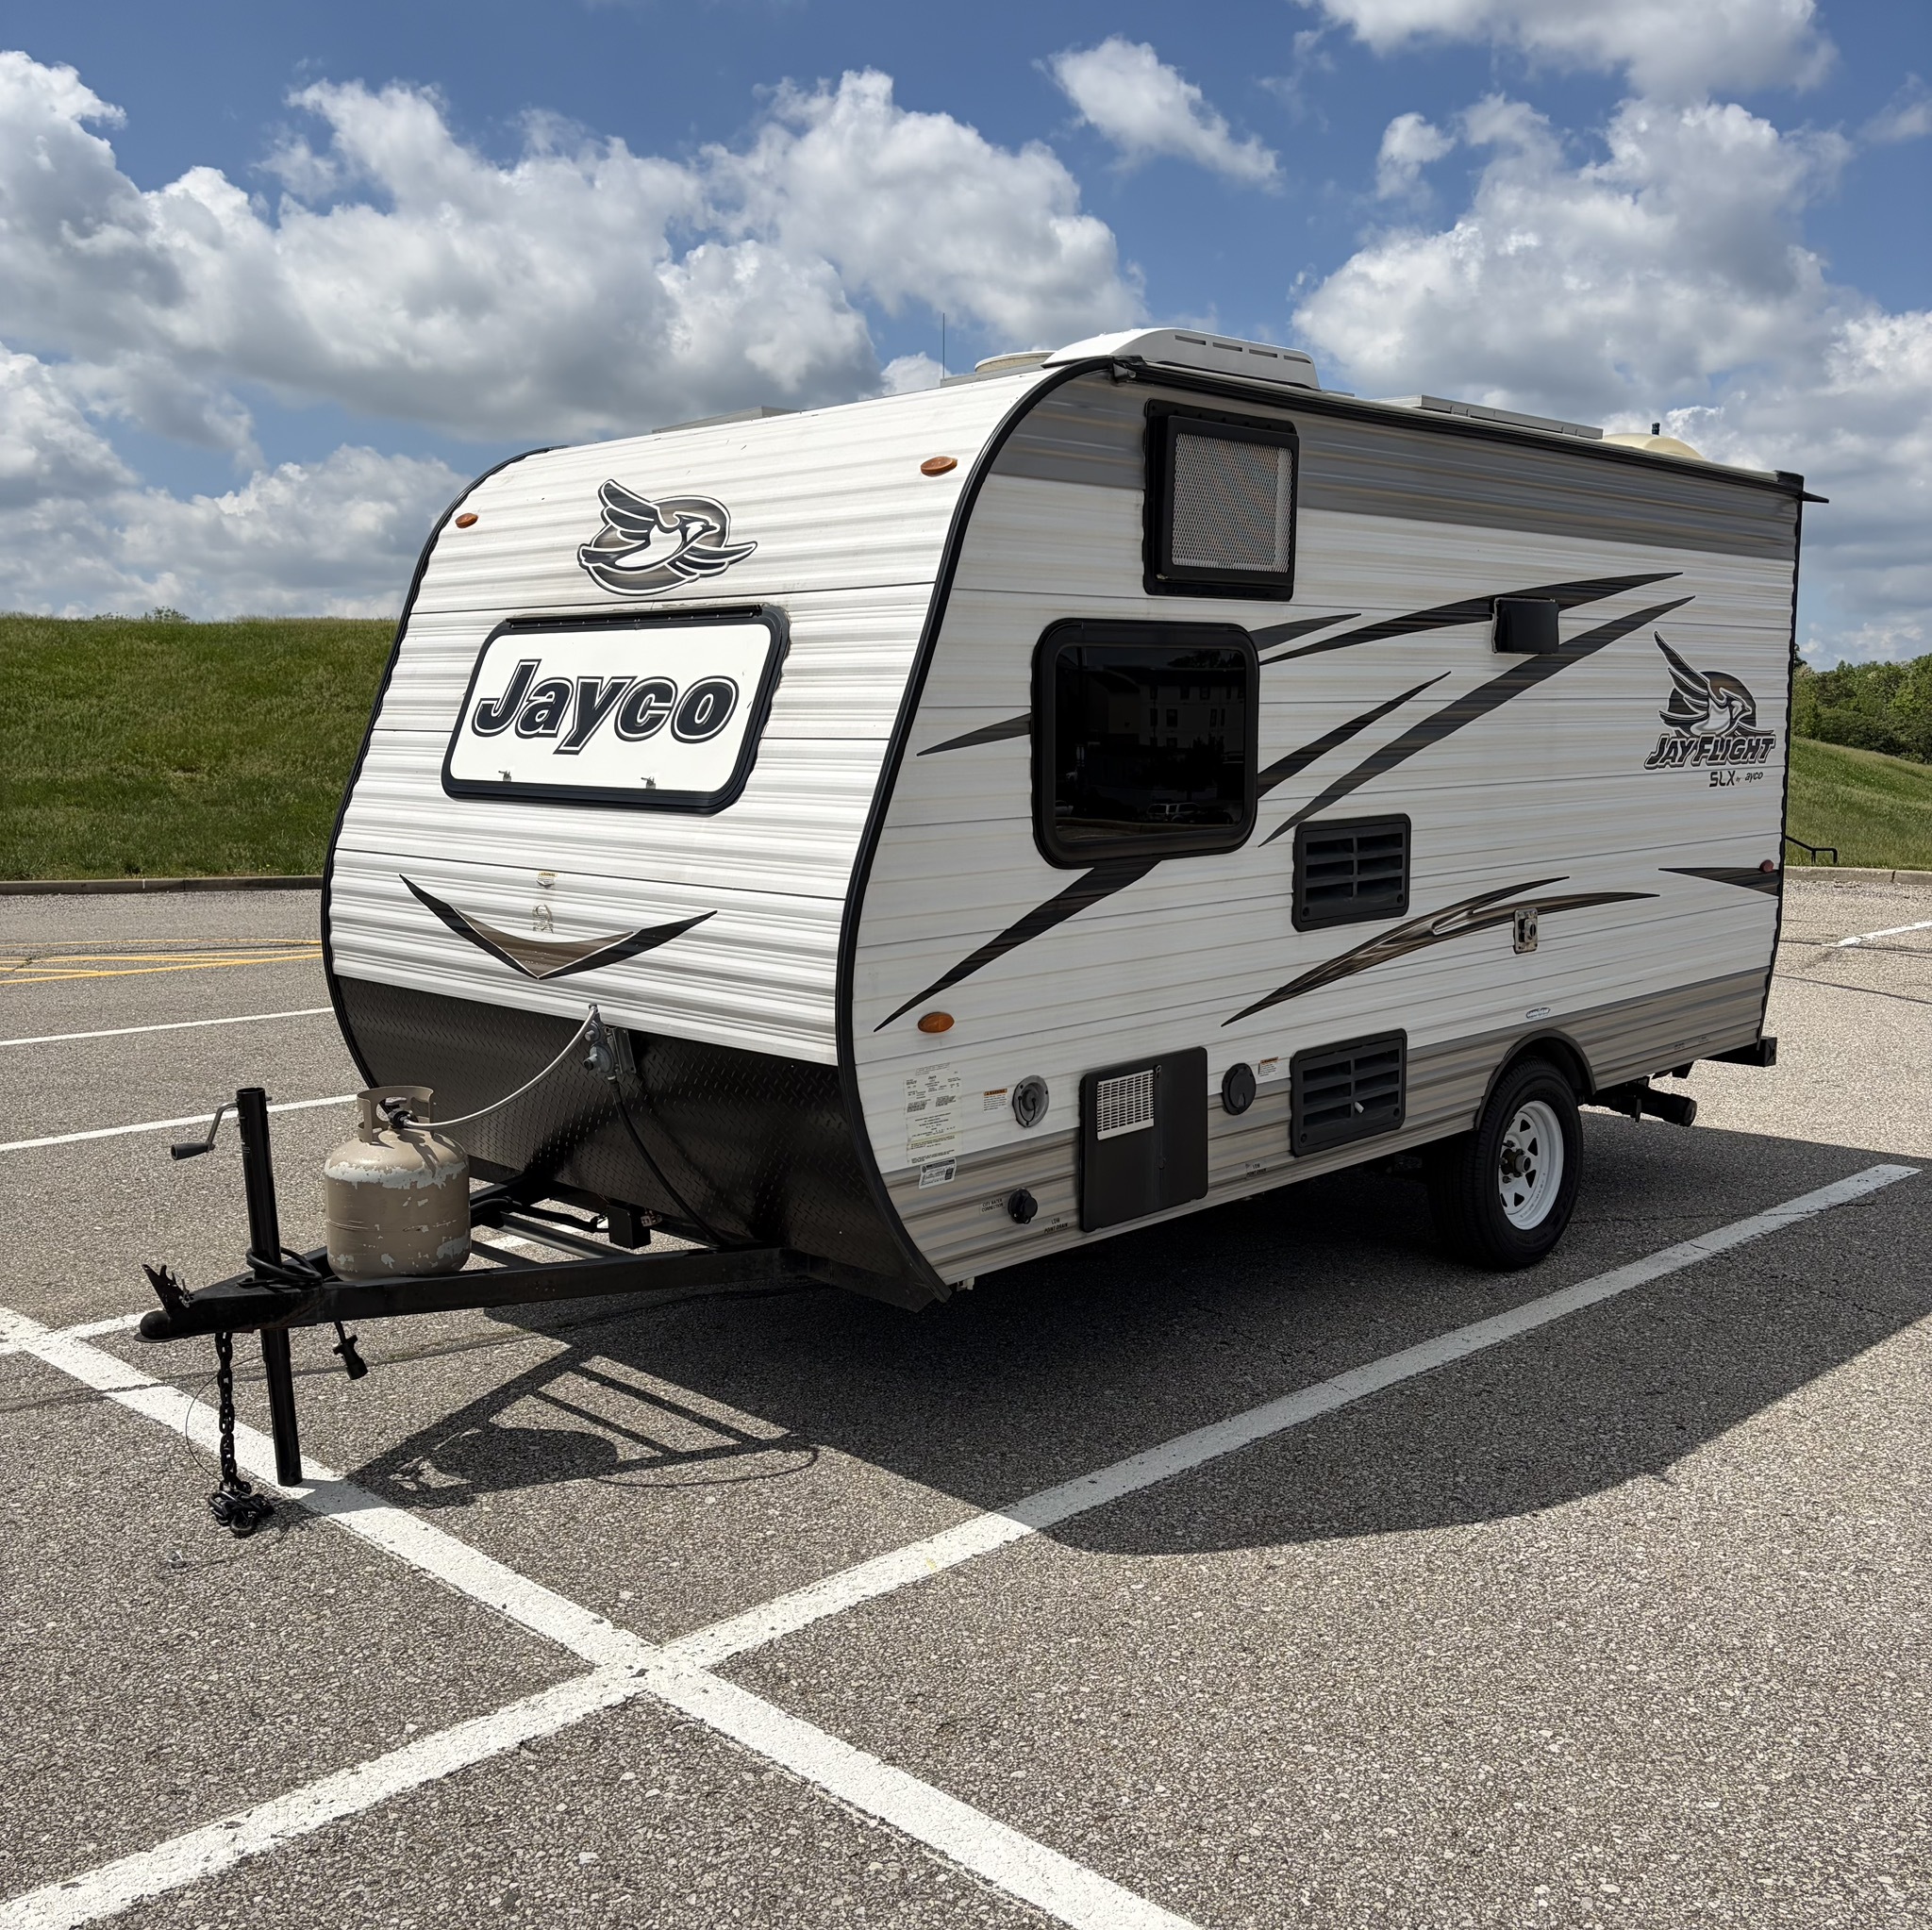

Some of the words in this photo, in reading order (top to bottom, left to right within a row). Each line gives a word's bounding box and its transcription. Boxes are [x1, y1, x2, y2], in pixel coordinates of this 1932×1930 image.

[472, 658, 740, 756] Jayco
[1709, 771, 1736, 788] SLX
[981, 1203, 1004, 1213] CONNECTION
[1043, 1225, 1057, 1234] POINT
